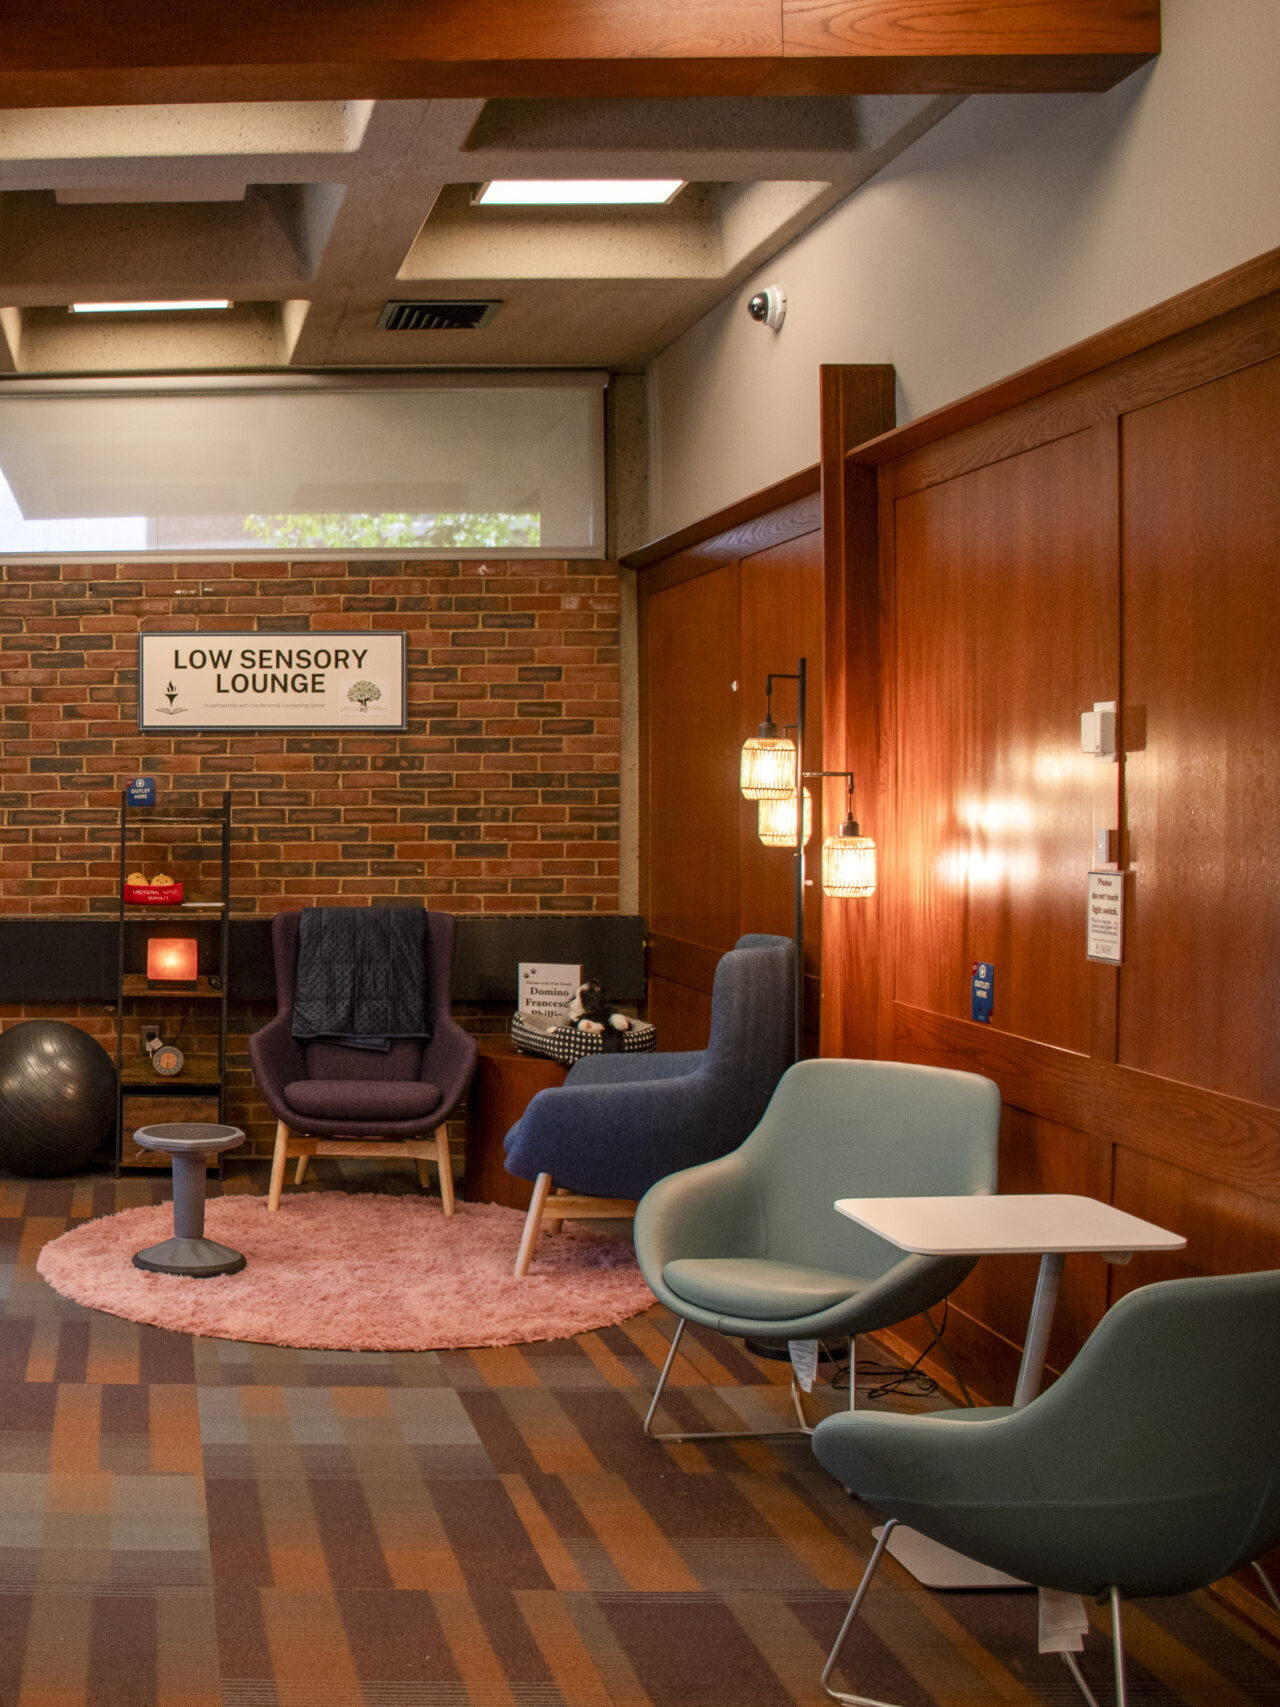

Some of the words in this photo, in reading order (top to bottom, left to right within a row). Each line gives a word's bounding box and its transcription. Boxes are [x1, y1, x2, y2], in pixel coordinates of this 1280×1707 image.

[174, 649, 233, 669] LOW
[240, 649, 368, 669] SENSORY
[216, 673, 326, 694] LOUNGE
[975, 980, 990, 989] OUTLET
[530, 987, 569, 996] Domino
[977, 990, 987, 998] HERE
[525, 998, 569, 1008] Francesc
